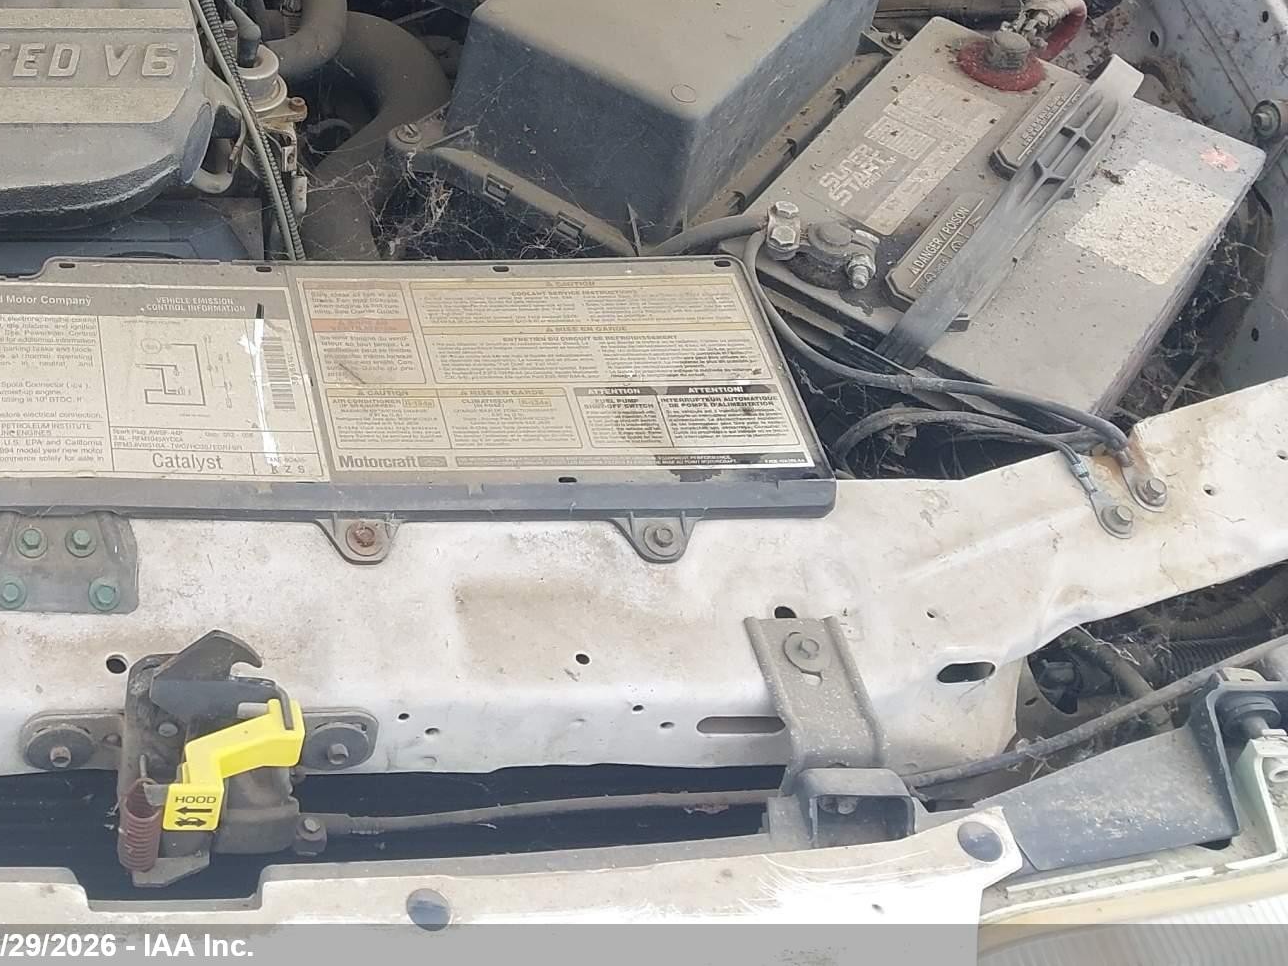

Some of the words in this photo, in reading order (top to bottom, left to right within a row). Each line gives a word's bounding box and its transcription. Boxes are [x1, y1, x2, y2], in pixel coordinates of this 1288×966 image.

[104, 42, 179, 77] V6
[915, 236, 944, 268] DANGER
[943, 206, 970, 235] POISON
[6, 294, 38, 305] Motor
[40, 295, 92, 307] Company
[156, 297, 191, 305] VEHICLE
[187, 305, 245, 313] INFORMATION
[688, 386, 744, 394] ATTENTION!
[152, 452, 223, 472] Catalyst
[339, 455, 417, 468] Motorcraft
[285, 465, 293, 474] Z
[297, 465, 305, 474] S
[175, 796, 216, 804] HOOD
